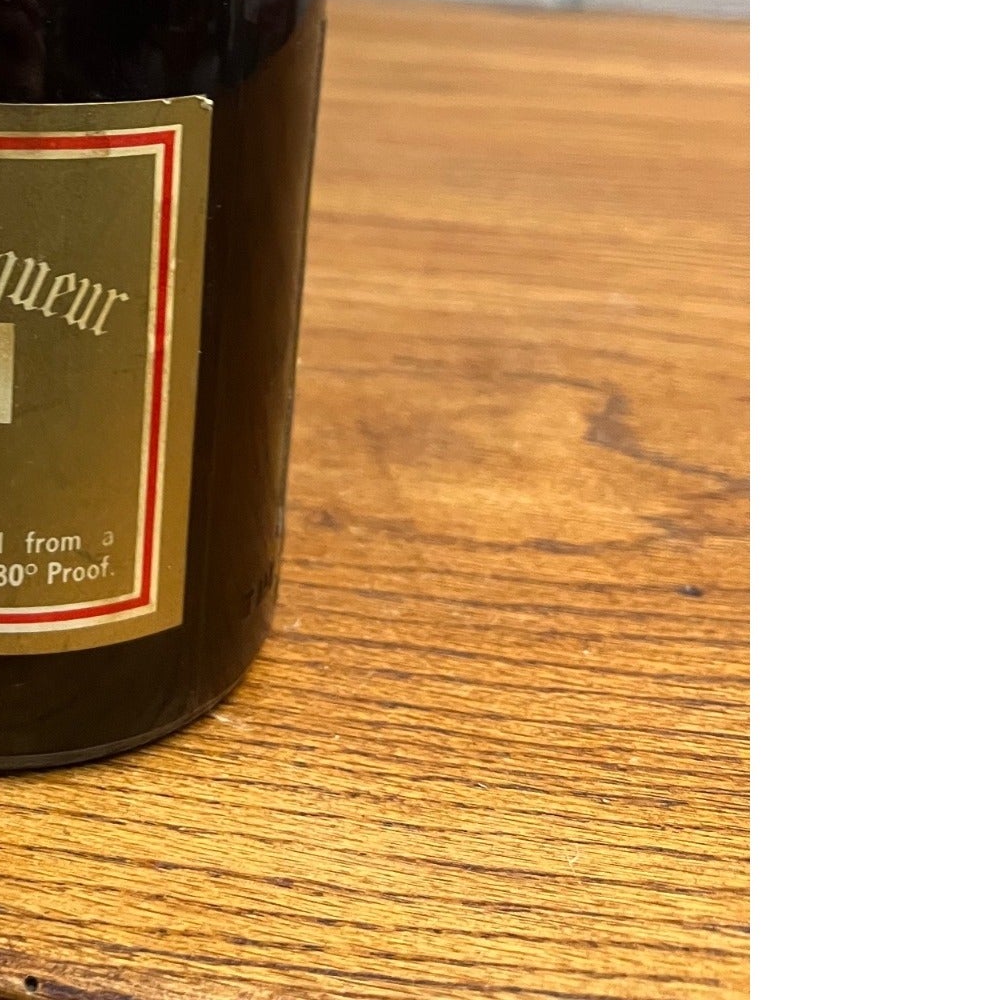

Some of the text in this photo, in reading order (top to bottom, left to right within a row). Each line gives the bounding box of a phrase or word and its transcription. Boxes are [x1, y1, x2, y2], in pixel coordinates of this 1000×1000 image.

[26, 531, 82, 553] from
[102, 531, 114, 547] a
[47, 555, 115, 585] Proof.
